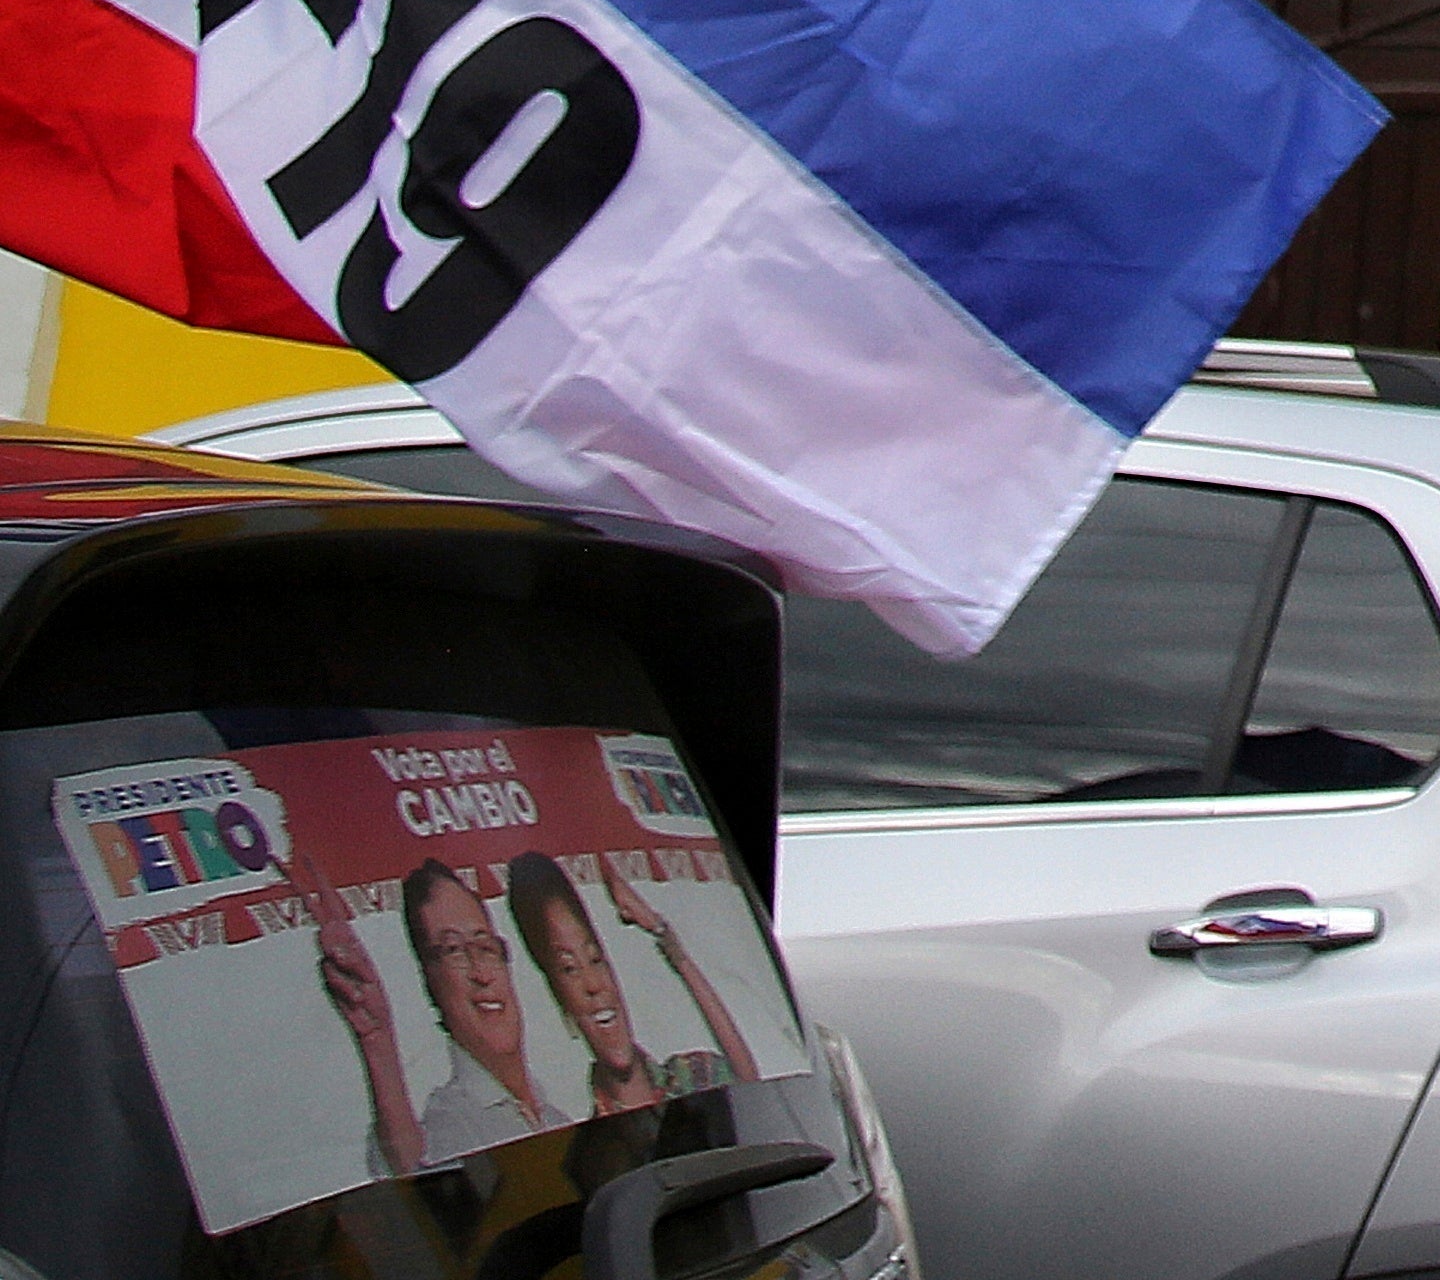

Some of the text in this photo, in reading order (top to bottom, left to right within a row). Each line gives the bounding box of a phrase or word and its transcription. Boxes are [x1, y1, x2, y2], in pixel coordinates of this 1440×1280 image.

[74, 770, 242, 817] PRESIDENTE
[396, 779, 539, 837] CAMBIO
[88, 802, 286, 898] PETRO
